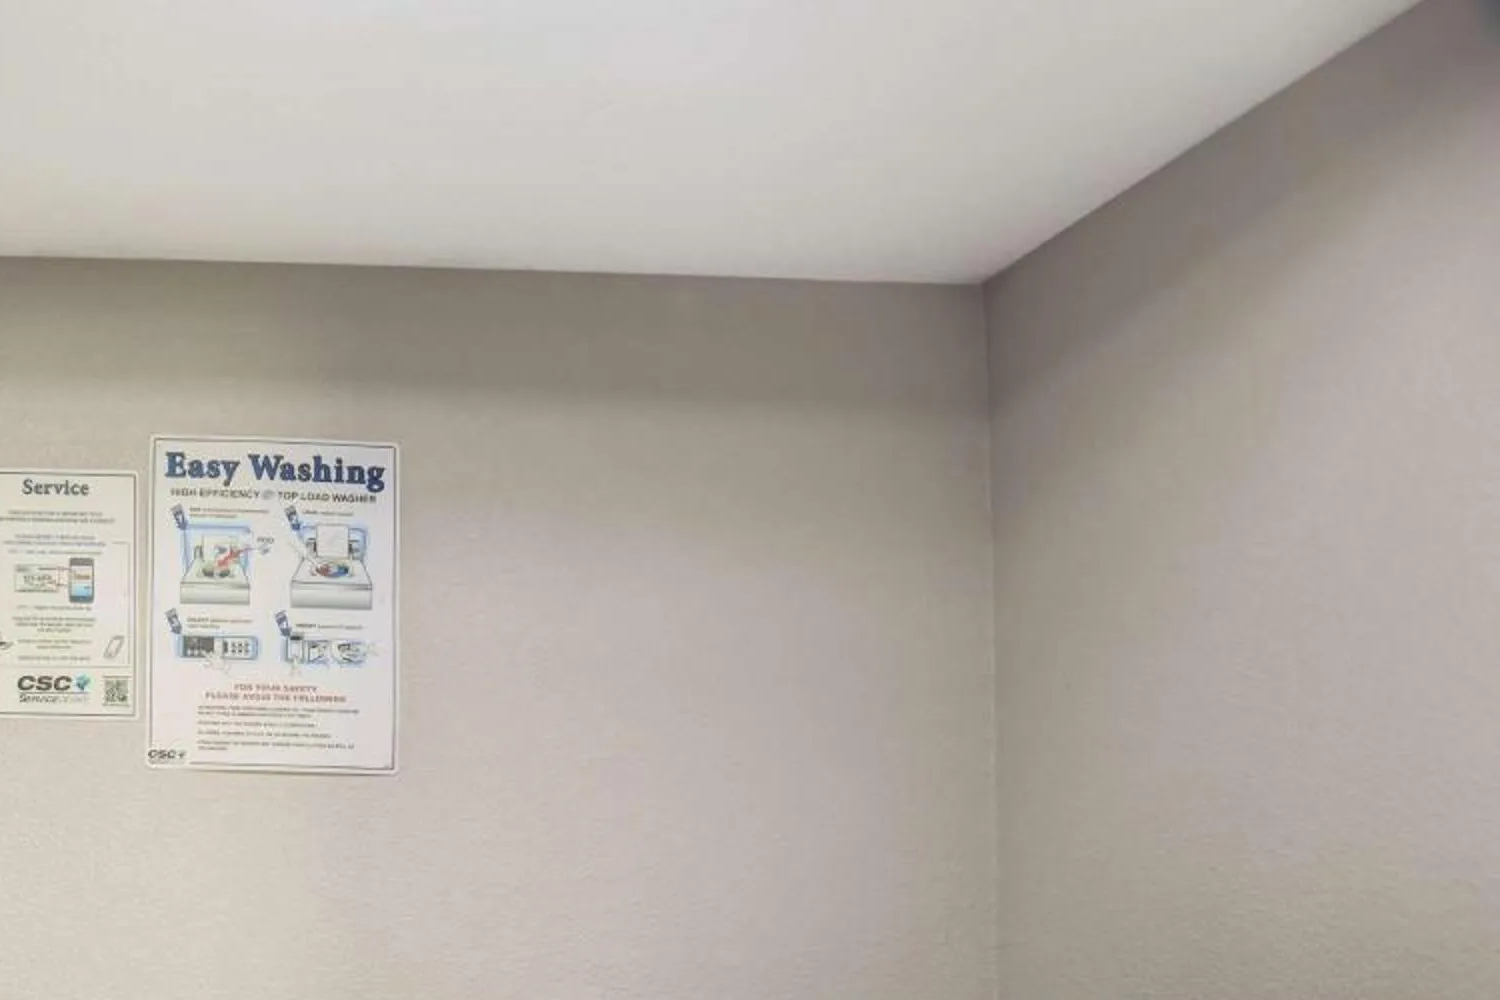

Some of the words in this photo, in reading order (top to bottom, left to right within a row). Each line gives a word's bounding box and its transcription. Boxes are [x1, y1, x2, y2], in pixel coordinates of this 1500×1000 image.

[165, 451, 240, 486] Easy
[248, 454, 386, 493] Washing
[22, 478, 89, 496] Service
[18, 675, 72, 691] CSC
[148, 749, 176, 759] CSC
